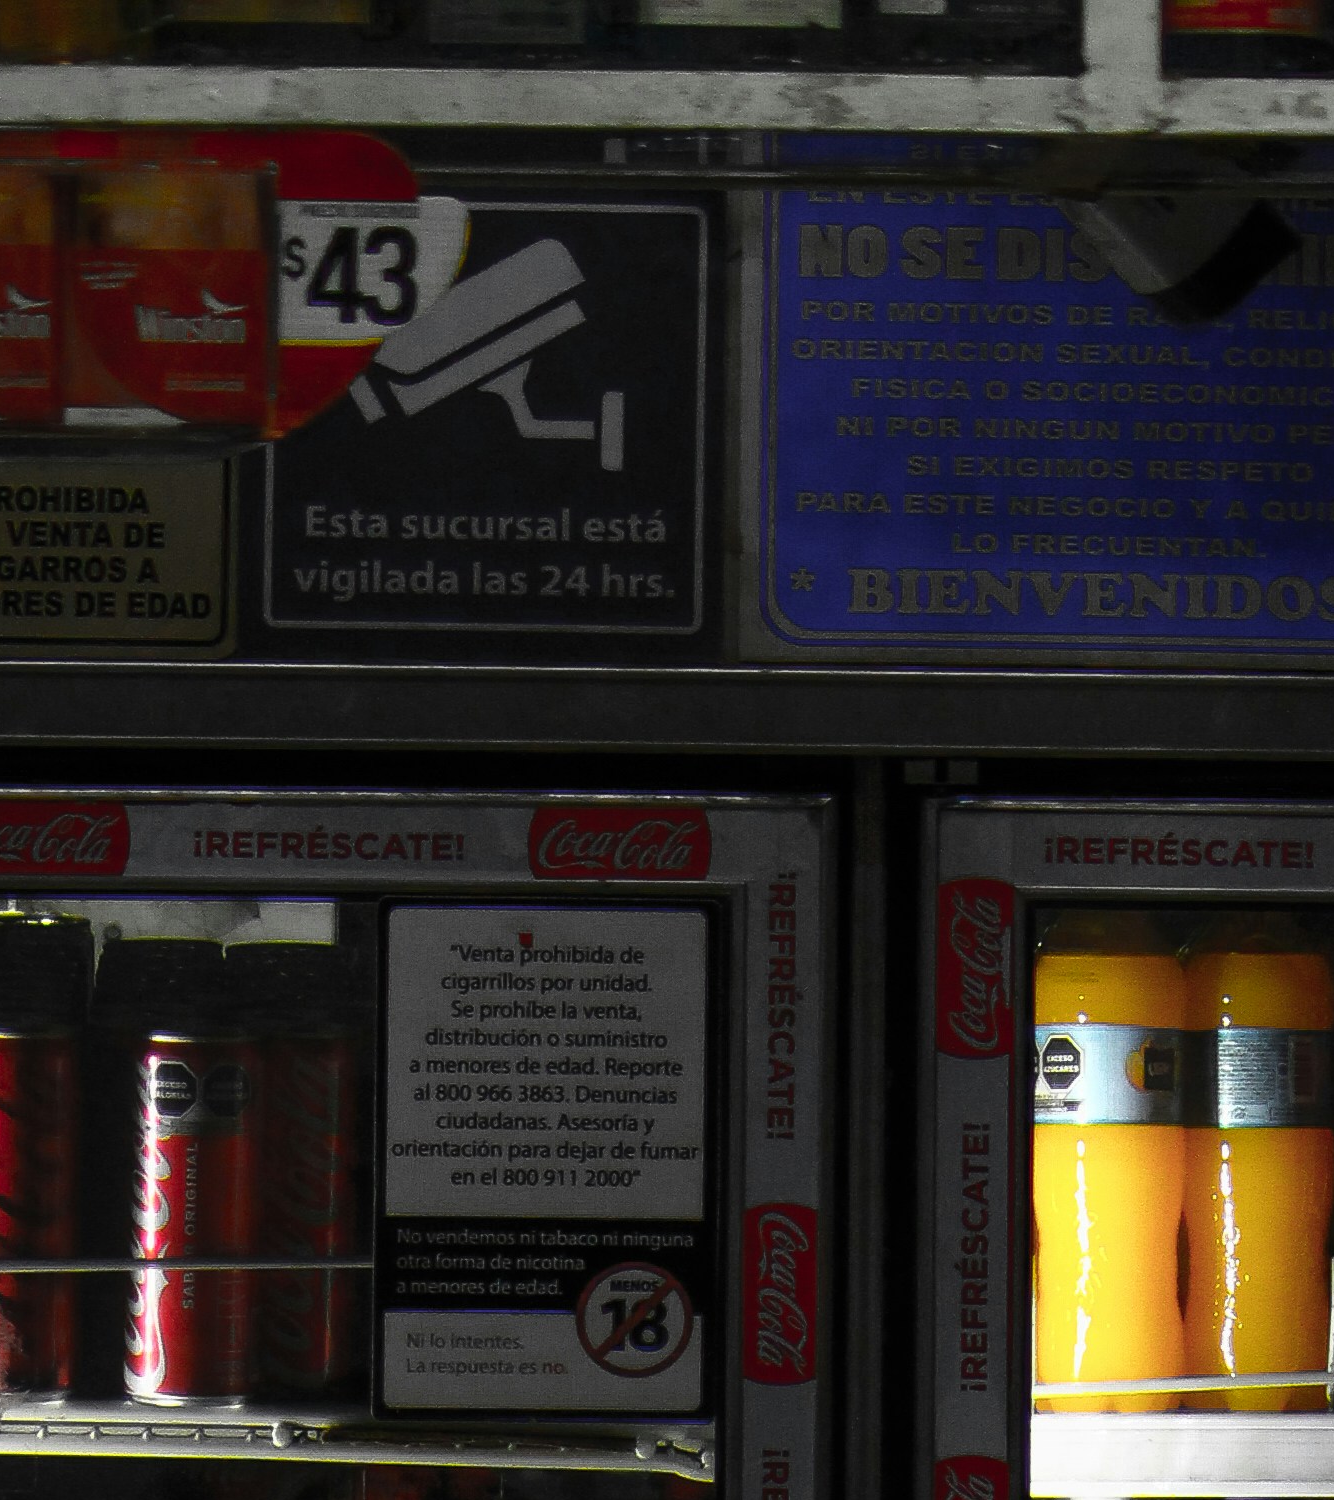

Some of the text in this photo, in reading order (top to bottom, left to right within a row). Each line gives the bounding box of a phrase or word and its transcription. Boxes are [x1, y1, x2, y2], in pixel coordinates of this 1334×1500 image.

[797, 223, 889, 279] NO
[899, 225, 985, 281] SE
[800, 299, 876, 323] POR
[886, 301, 1056, 326] MOTIVOS
[1066, 304, 1114, 328] DE
[790, 337, 1045, 364] ORIENTACION
[850, 376, 972, 401] FISICA
[982, 379, 1010, 402] O
[834, 414, 875, 438] NI
[885, 415, 962, 439] POR
[973, 417, 1121, 442] NINGUN
[1132, 420, 1276, 445] MOTIVO
[906, 453, 1314, 484] SI EXIGIMOS RESPETO
[794, 490, 892, 515] PARA
[902, 492, 995, 517] ESTE
[1007, 495, 1177, 520] NEGOCIO
[1189, 498, 1212, 520] Y
[1224, 499, 1249, 522] A
[5, 520, 113, 548] VENTA
[123, 522, 165, 549] DE
[305, 504, 667, 543] Esta sucursal está
[950, 531, 999, 555] LO
[136, 557, 159, 584] A
[293, 559, 675, 602] vigilada las 24 hrs.
[74, 591, 116, 618] DE
[127, 591, 212, 620] EDAD
[518, 944, 616, 967] prohibida
[619, 945, 646, 965] de
[440, 972, 536, 995] cigarrillos
[540, 976, 575, 995] por
[450, 999, 475, 1018] Se
[560, 1000, 578, 1020] la
[424, 1026, 669, 1049] distribución o suministro
[409, 1059, 421, 1074] a
[425, 1059, 512, 1075] menores
[515, 1056, 542, 1075] de
[604, 1056, 684, 1081] Reporte
[413, 1083, 431, 1102] al
[435, 1083, 473, 1102] 800
[476, 1083, 513, 1102] 966
[574, 1084, 678, 1105] Denuncias
[556, 1112, 640, 1132] Asesoría
[642, 1118, 656, 1137] y
[390, 1138, 700, 1164] orientación para dejar de fumar
[450, 1171, 476, 1186] en
[479, 1167, 498, 1186] el
[502, 1168, 540, 1187] 800
[544, 1168, 578, 1187] 911
[396, 1227, 695, 1252] No vendemos ni tabaco ni ninguna
[395, 1253, 586, 1271] otra forma de nicotina
[396, 1280, 407, 1294] a
[410, 1280, 486, 1295] menores
[487, 1277, 513, 1296] de
[600, 1297, 670, 1353] 18
[406, 1332, 426, 1348] Ni
[429, 1332, 447, 1349] lo
[406, 1358, 427, 1374] La
[429, 1359, 516, 1377] respuesta
[517, 1361, 539, 1376] es
